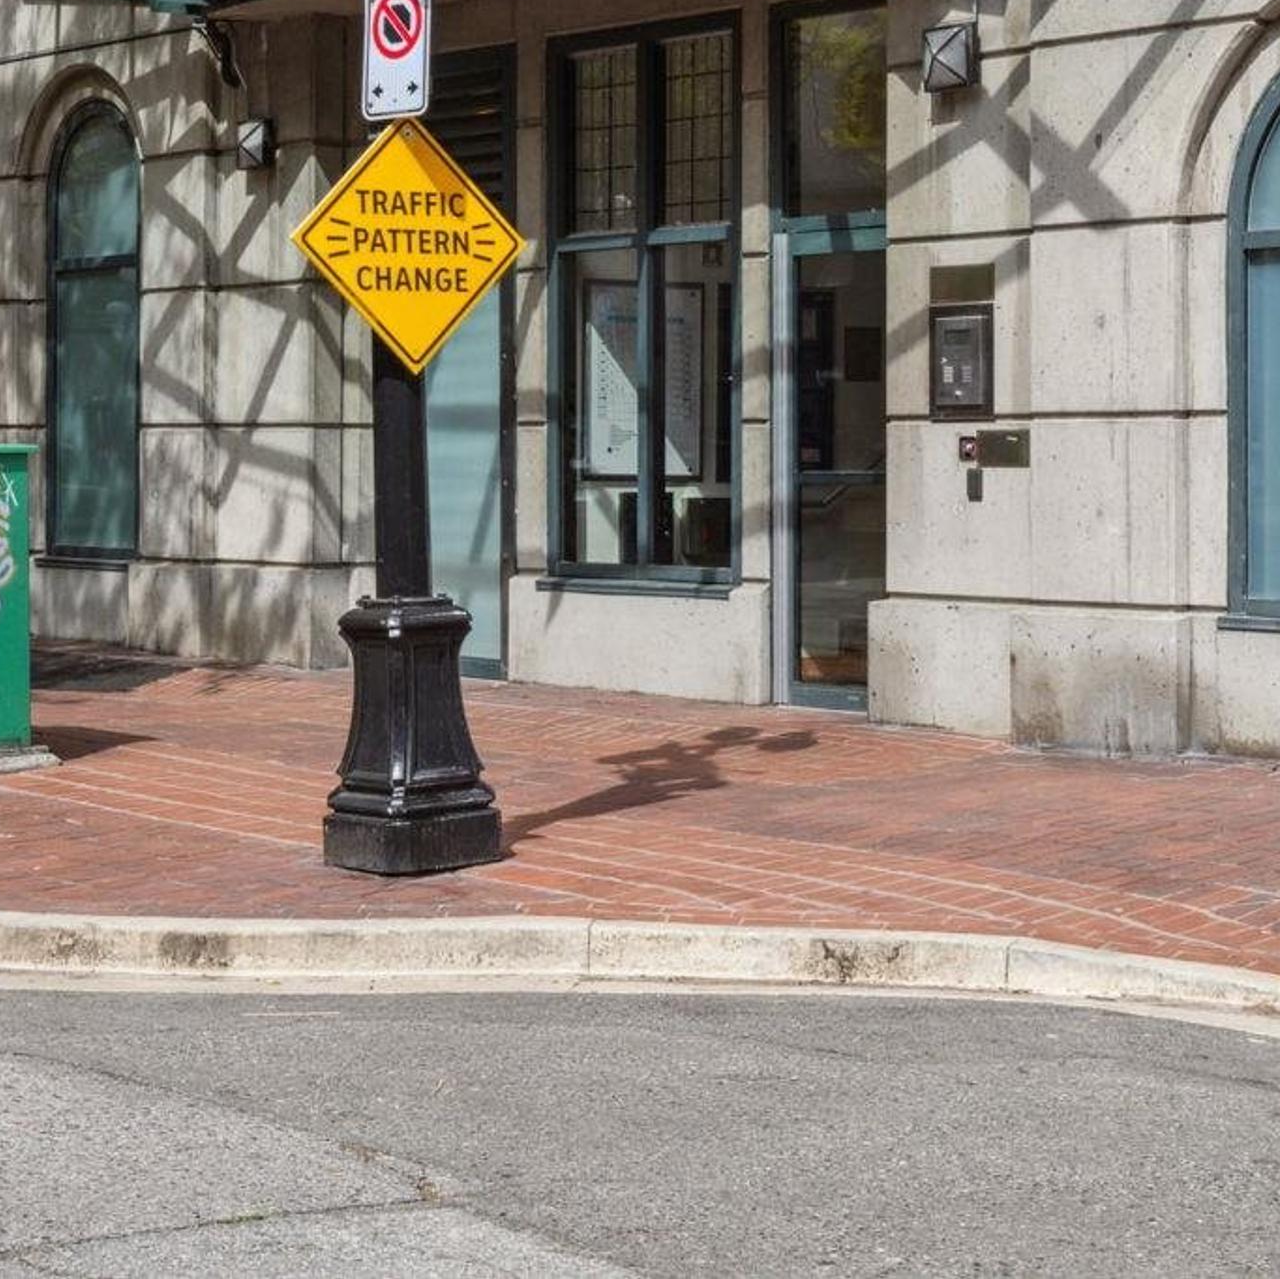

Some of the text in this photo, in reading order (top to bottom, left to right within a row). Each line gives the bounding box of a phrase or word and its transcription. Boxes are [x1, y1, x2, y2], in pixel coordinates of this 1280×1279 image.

[355, 189, 465, 218] TRAFFIC
[353, 227, 469, 255] PATTERN
[356, 266, 469, 293] CHANGE
